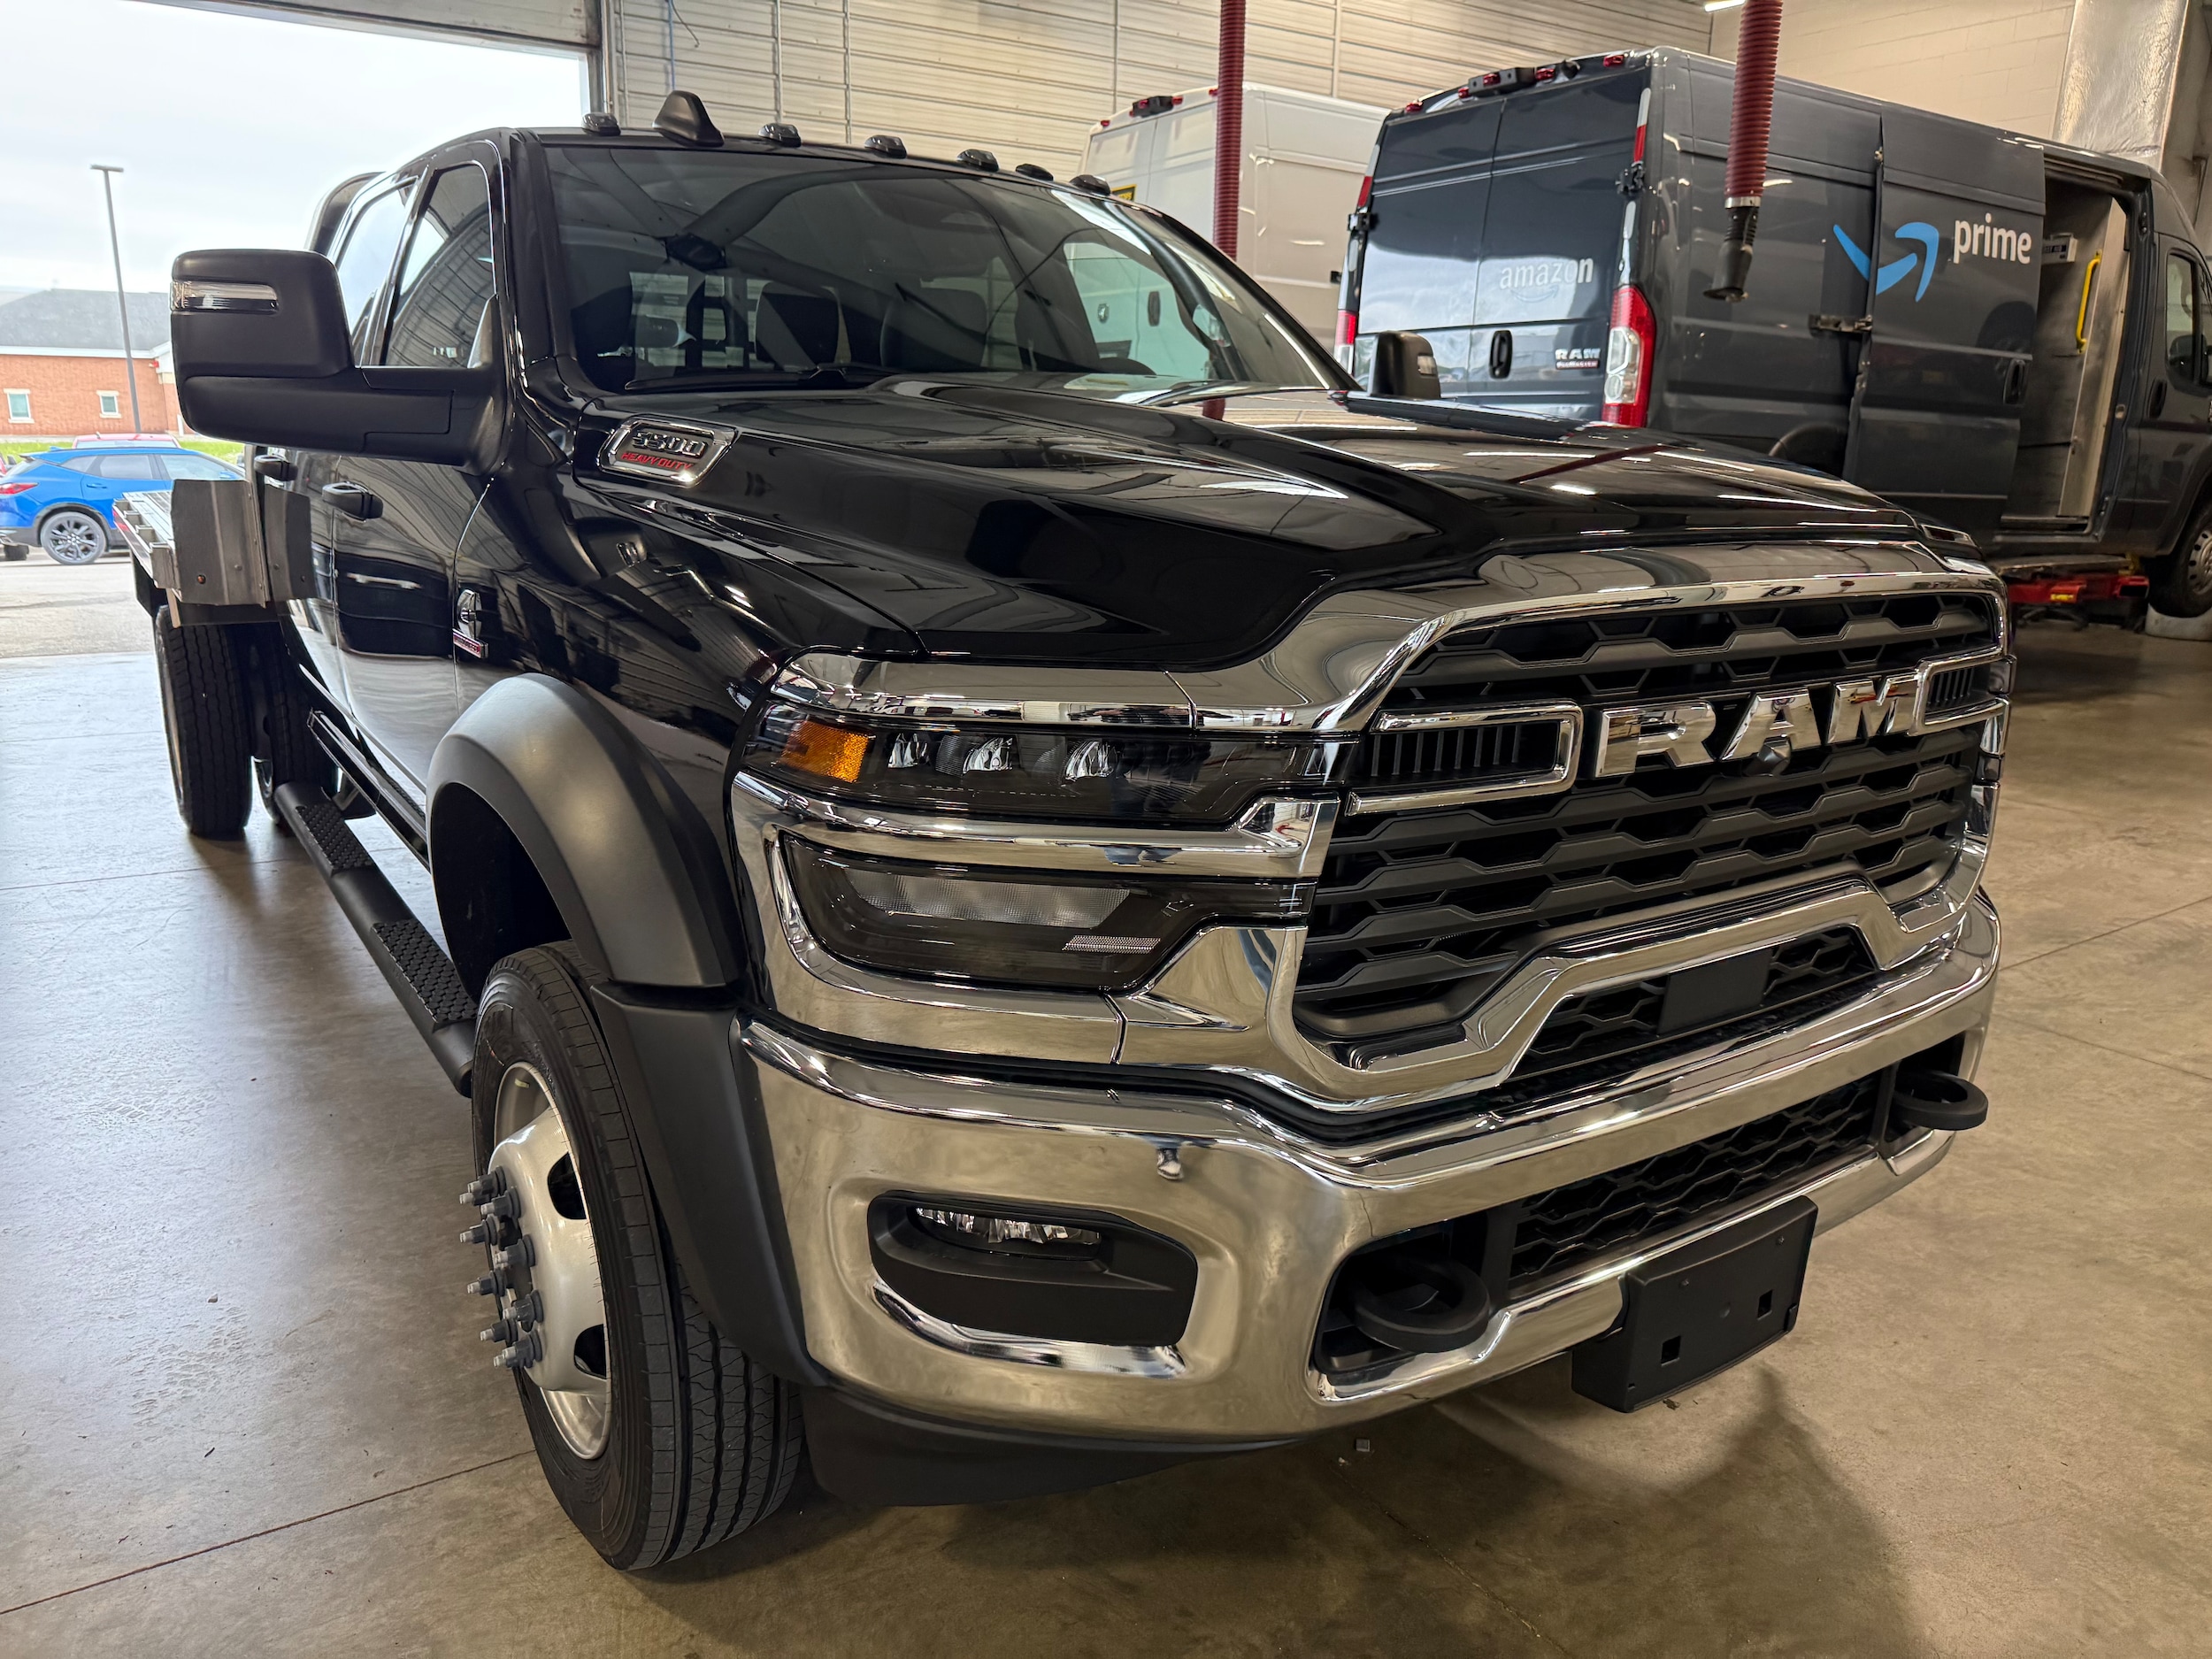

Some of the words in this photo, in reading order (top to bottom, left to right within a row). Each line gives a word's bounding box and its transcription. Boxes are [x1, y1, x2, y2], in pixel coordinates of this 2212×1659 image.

[1953, 212, 2032, 264] prime
[1500, 257, 1594, 289] amazon
[1555, 349, 1601, 359] RAM
[632, 431, 706, 457] 5500
[621, 452, 659, 465] HEAVY
[657, 458, 694, 470] DUTY
[1594, 674, 1919, 778] RAM
